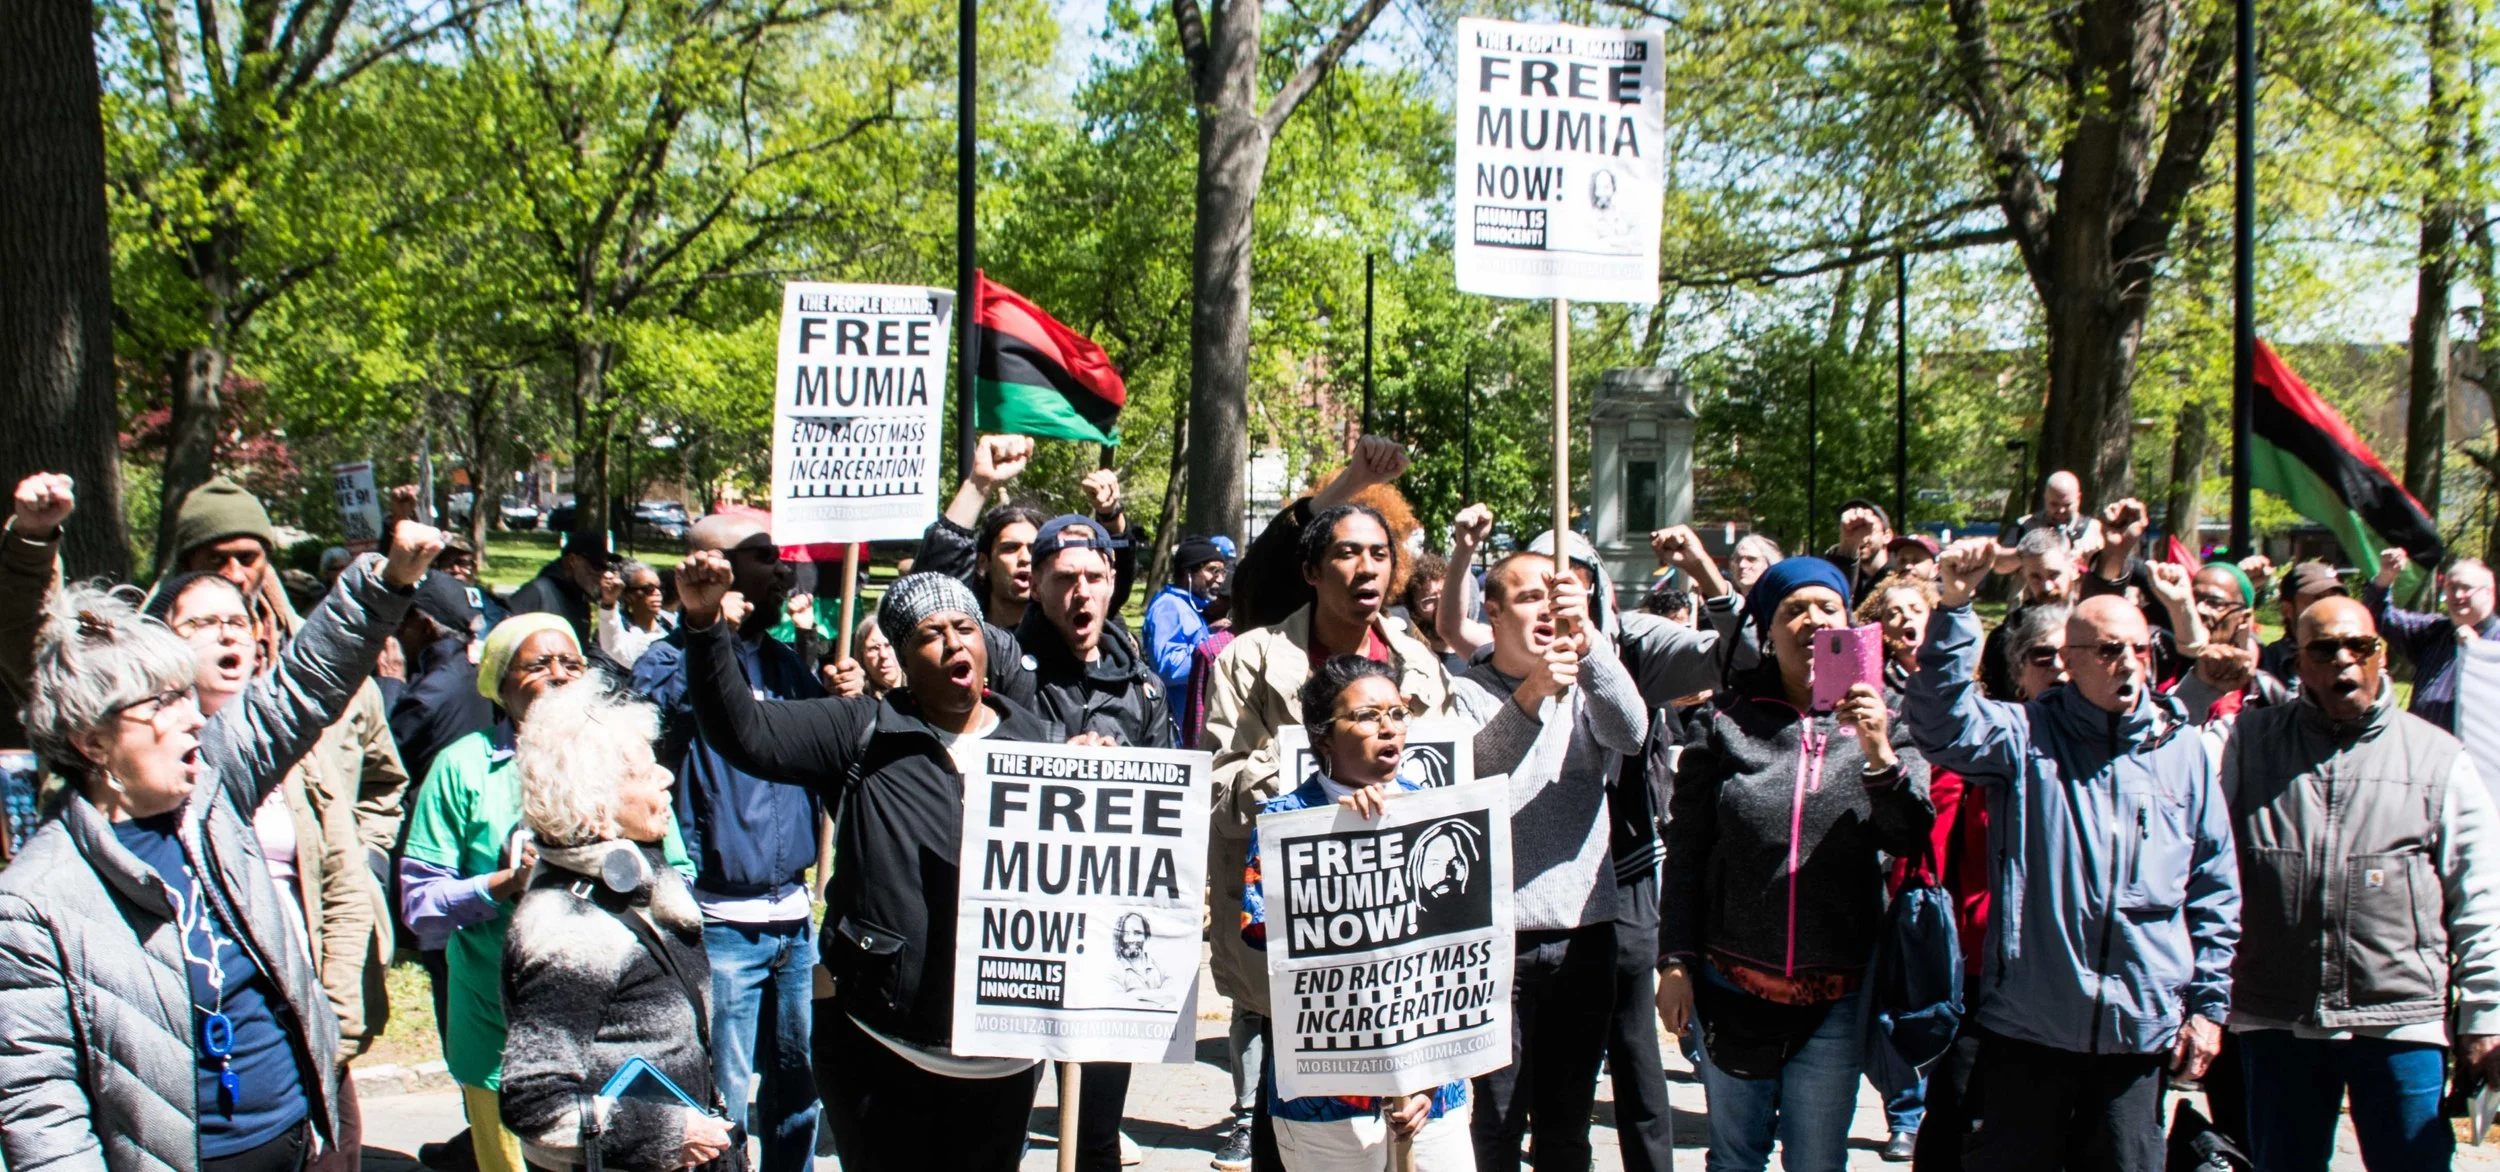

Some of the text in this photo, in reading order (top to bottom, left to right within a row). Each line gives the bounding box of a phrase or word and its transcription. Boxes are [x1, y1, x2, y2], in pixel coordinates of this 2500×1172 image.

[1480, 56, 1642, 104] FREE
[1477, 105, 1640, 157] MUMIA
[1477, 162, 1563, 201] NOW!
[1475, 224, 1543, 245] INNOCENT!
[1476, 207, 1544, 229] MUMIA IS
[802, 294, 933, 315] THE PEOPLE DEMAND:
[799, 318, 931, 356] FREE
[794, 365, 928, 407] MUMIA
[792, 422, 926, 444] END RACIST MASS
[790, 457, 925, 481] INCARCERATION!
[991, 753, 1185, 783] THE PEOPLE DEMAND:
[988, 781, 1184, 838] FREE
[982, 839, 1180, 899] MUMIA
[1288, 832, 1405, 879] FREE
[1290, 868, 1408, 915] MUMIA
[981, 907, 1086, 954] NOW!
[1293, 900, 1418, 950] NOW!
[981, 960, 1062, 983] MUMIA IS
[1294, 940, 1491, 996] END RACIST MASS
[980, 980, 1060, 1002] INNOCENT!
[1296, 980, 1495, 1035] INCARCERATION!
